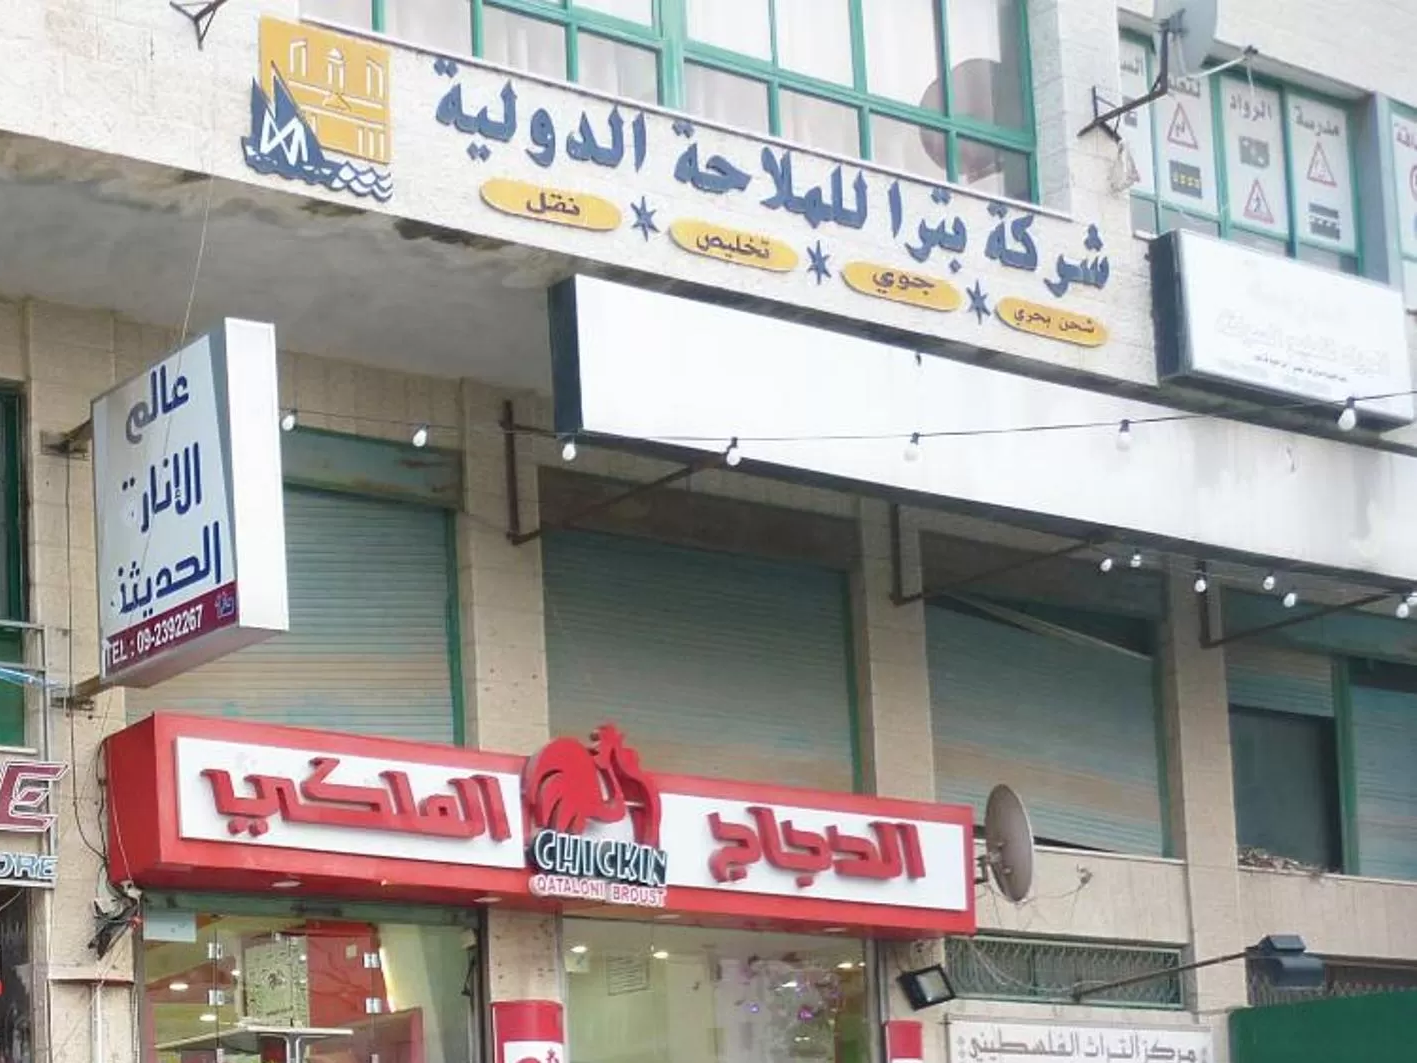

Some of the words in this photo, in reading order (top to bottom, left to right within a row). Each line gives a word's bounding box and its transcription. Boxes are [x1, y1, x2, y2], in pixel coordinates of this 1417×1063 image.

[435, 57, 648, 167] الدولية
[525, 191, 582, 217] نقل
[672, 122, 870, 228] للملاحة
[695, 230, 771, 260] تخليص
[888, 180, 968, 274] بترا
[984, 201, 1111, 297] شركة
[871, 271, 936, 296] جوي
[1013, 306, 1052, 327] بحري
[1058, 317, 1096, 334] شحن
[125, 364, 191, 446] عالم
[136, 604, 204, 654] 09-2392267
[198, 756, 513, 842] الملكي
[533, 829, 669, 887] CHICKIN
[705, 805, 928, 888] الدجاج
[968, 1027, 1081, 1063] الفلسطيني
